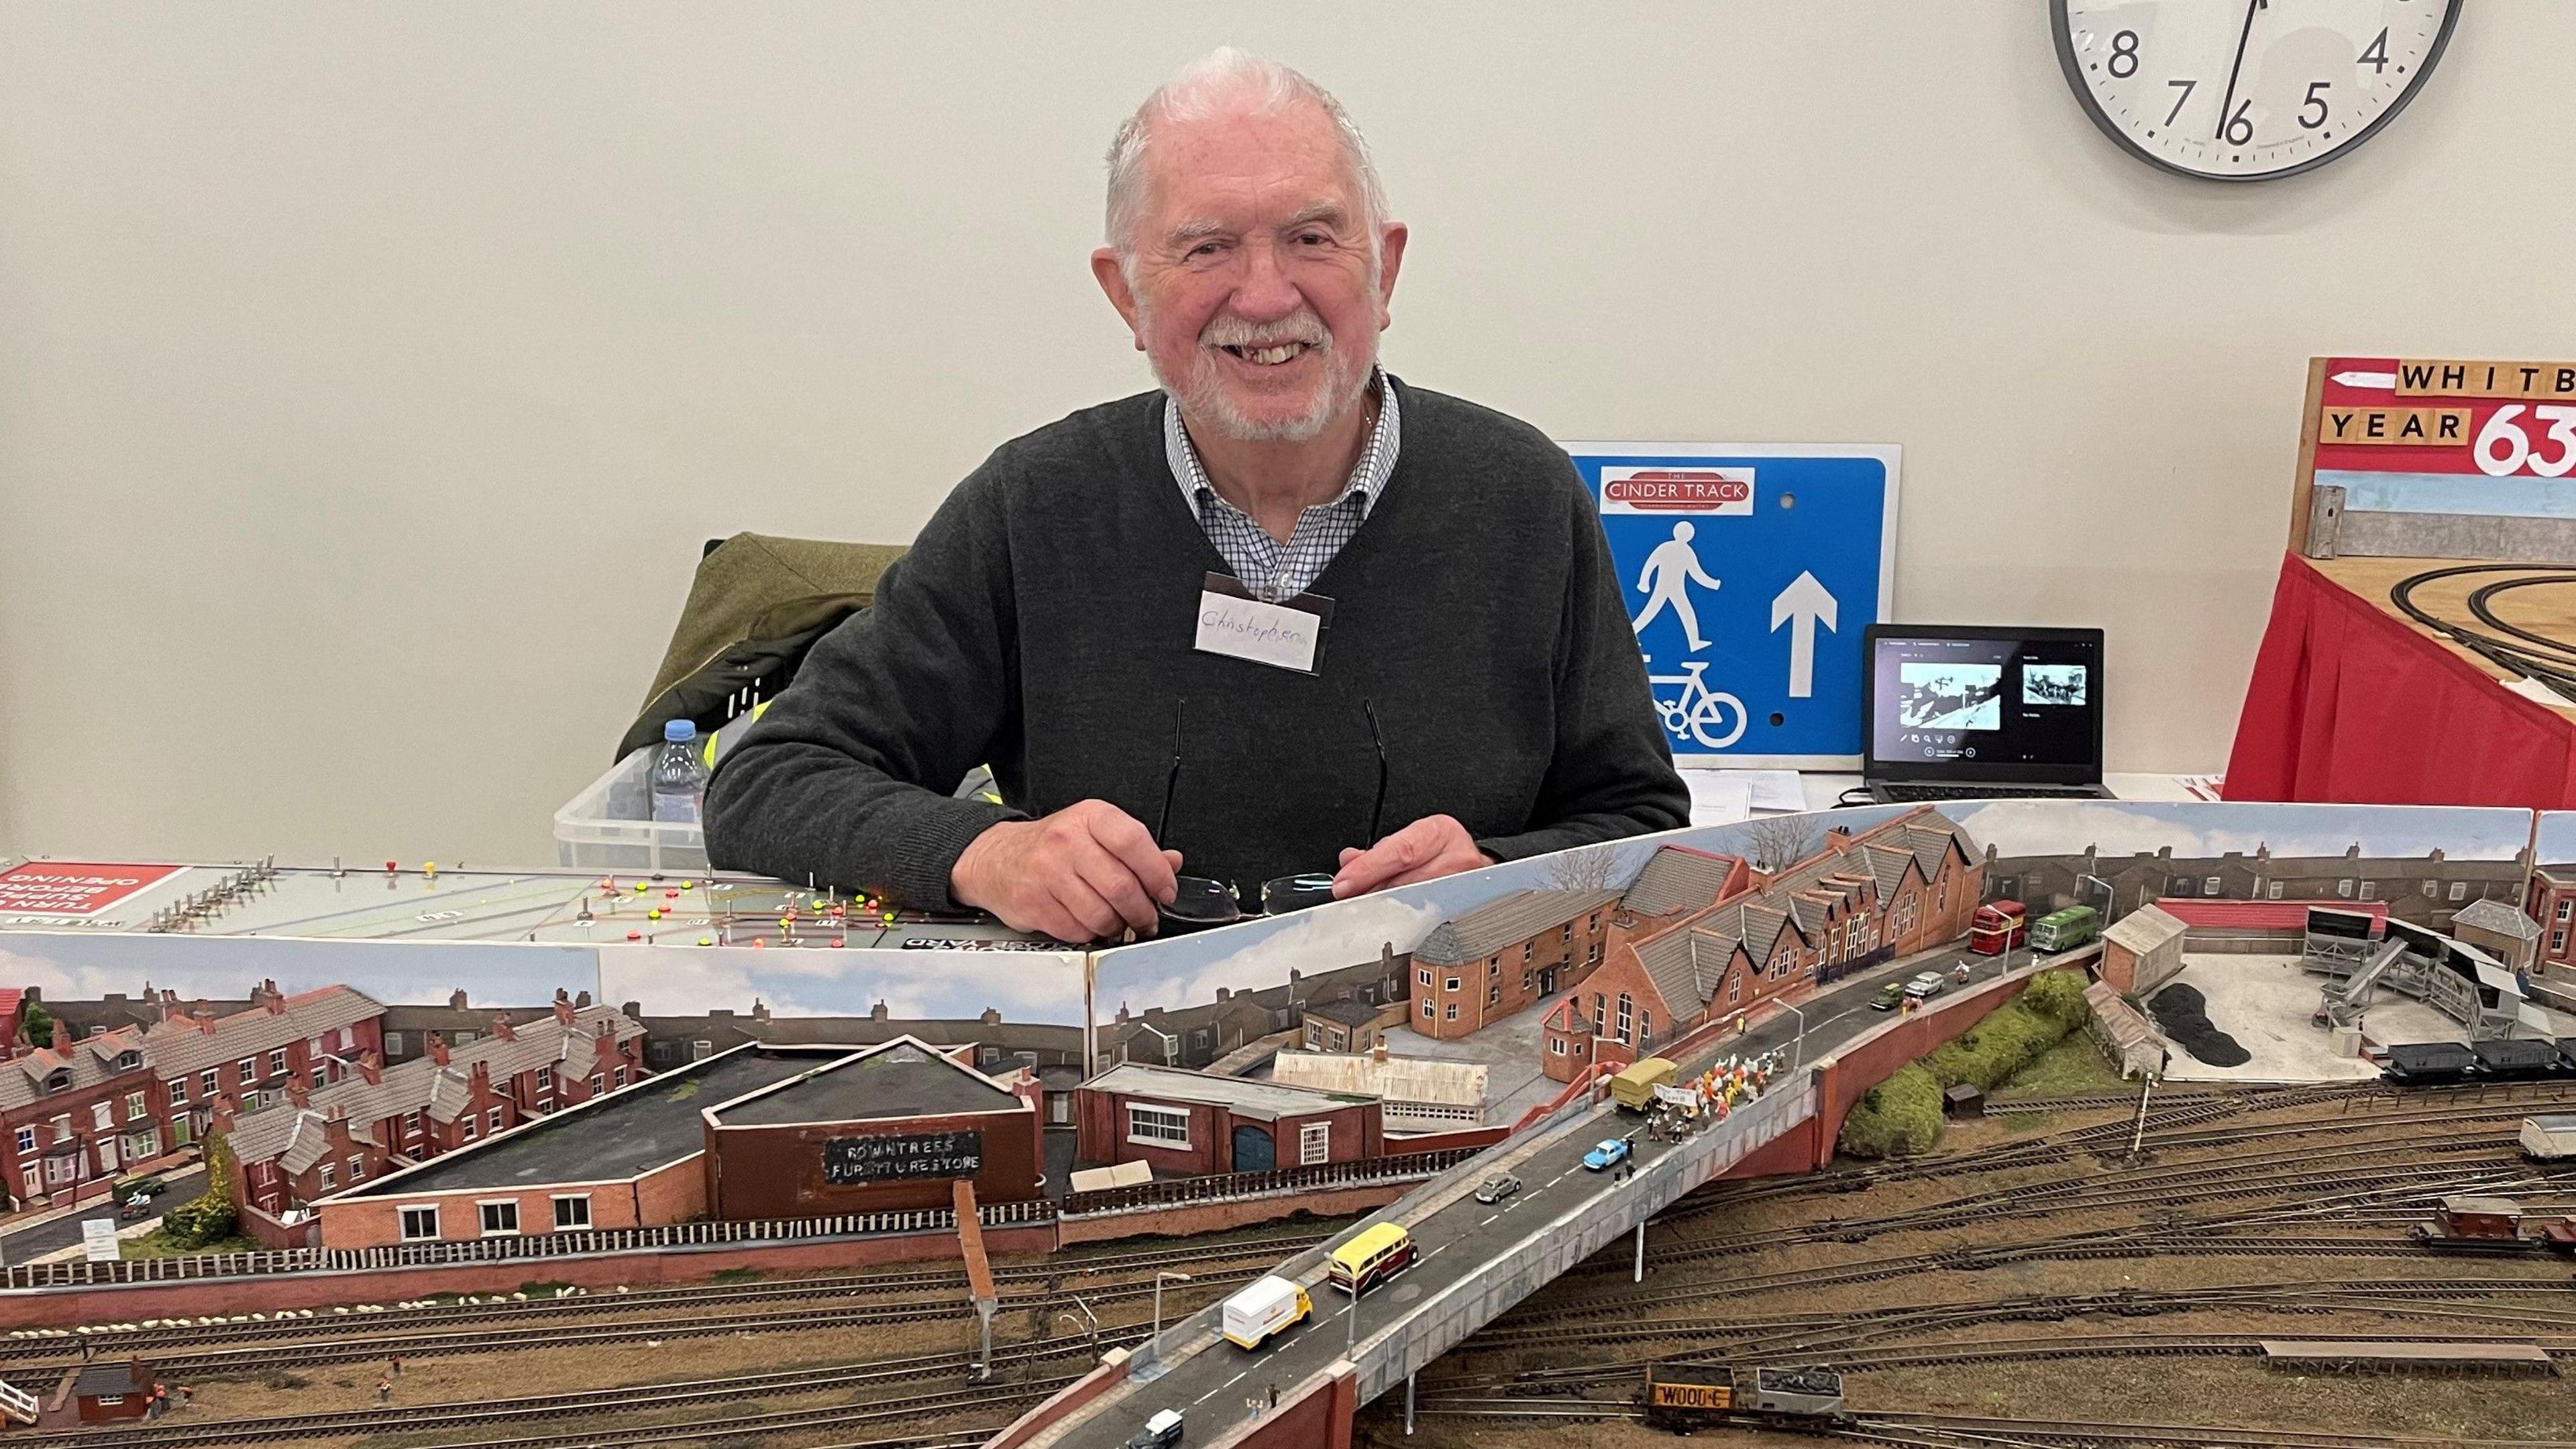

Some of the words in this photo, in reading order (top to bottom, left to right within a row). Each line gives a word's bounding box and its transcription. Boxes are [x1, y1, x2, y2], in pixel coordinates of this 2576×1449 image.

[2108, 30, 2139, 78] 8
[2356, 26, 2390, 74] 4
[2165, 80, 2197, 127] 7
[2224, 99, 2254, 146] 6
[2298, 82, 2330, 129] 5
[2331, 414, 2460, 438] YEAR
[1610, 483, 1678, 498] CINDER
[1684, 484, 1745, 498] TRACK
[7, 875, 140, 885] OPENING
